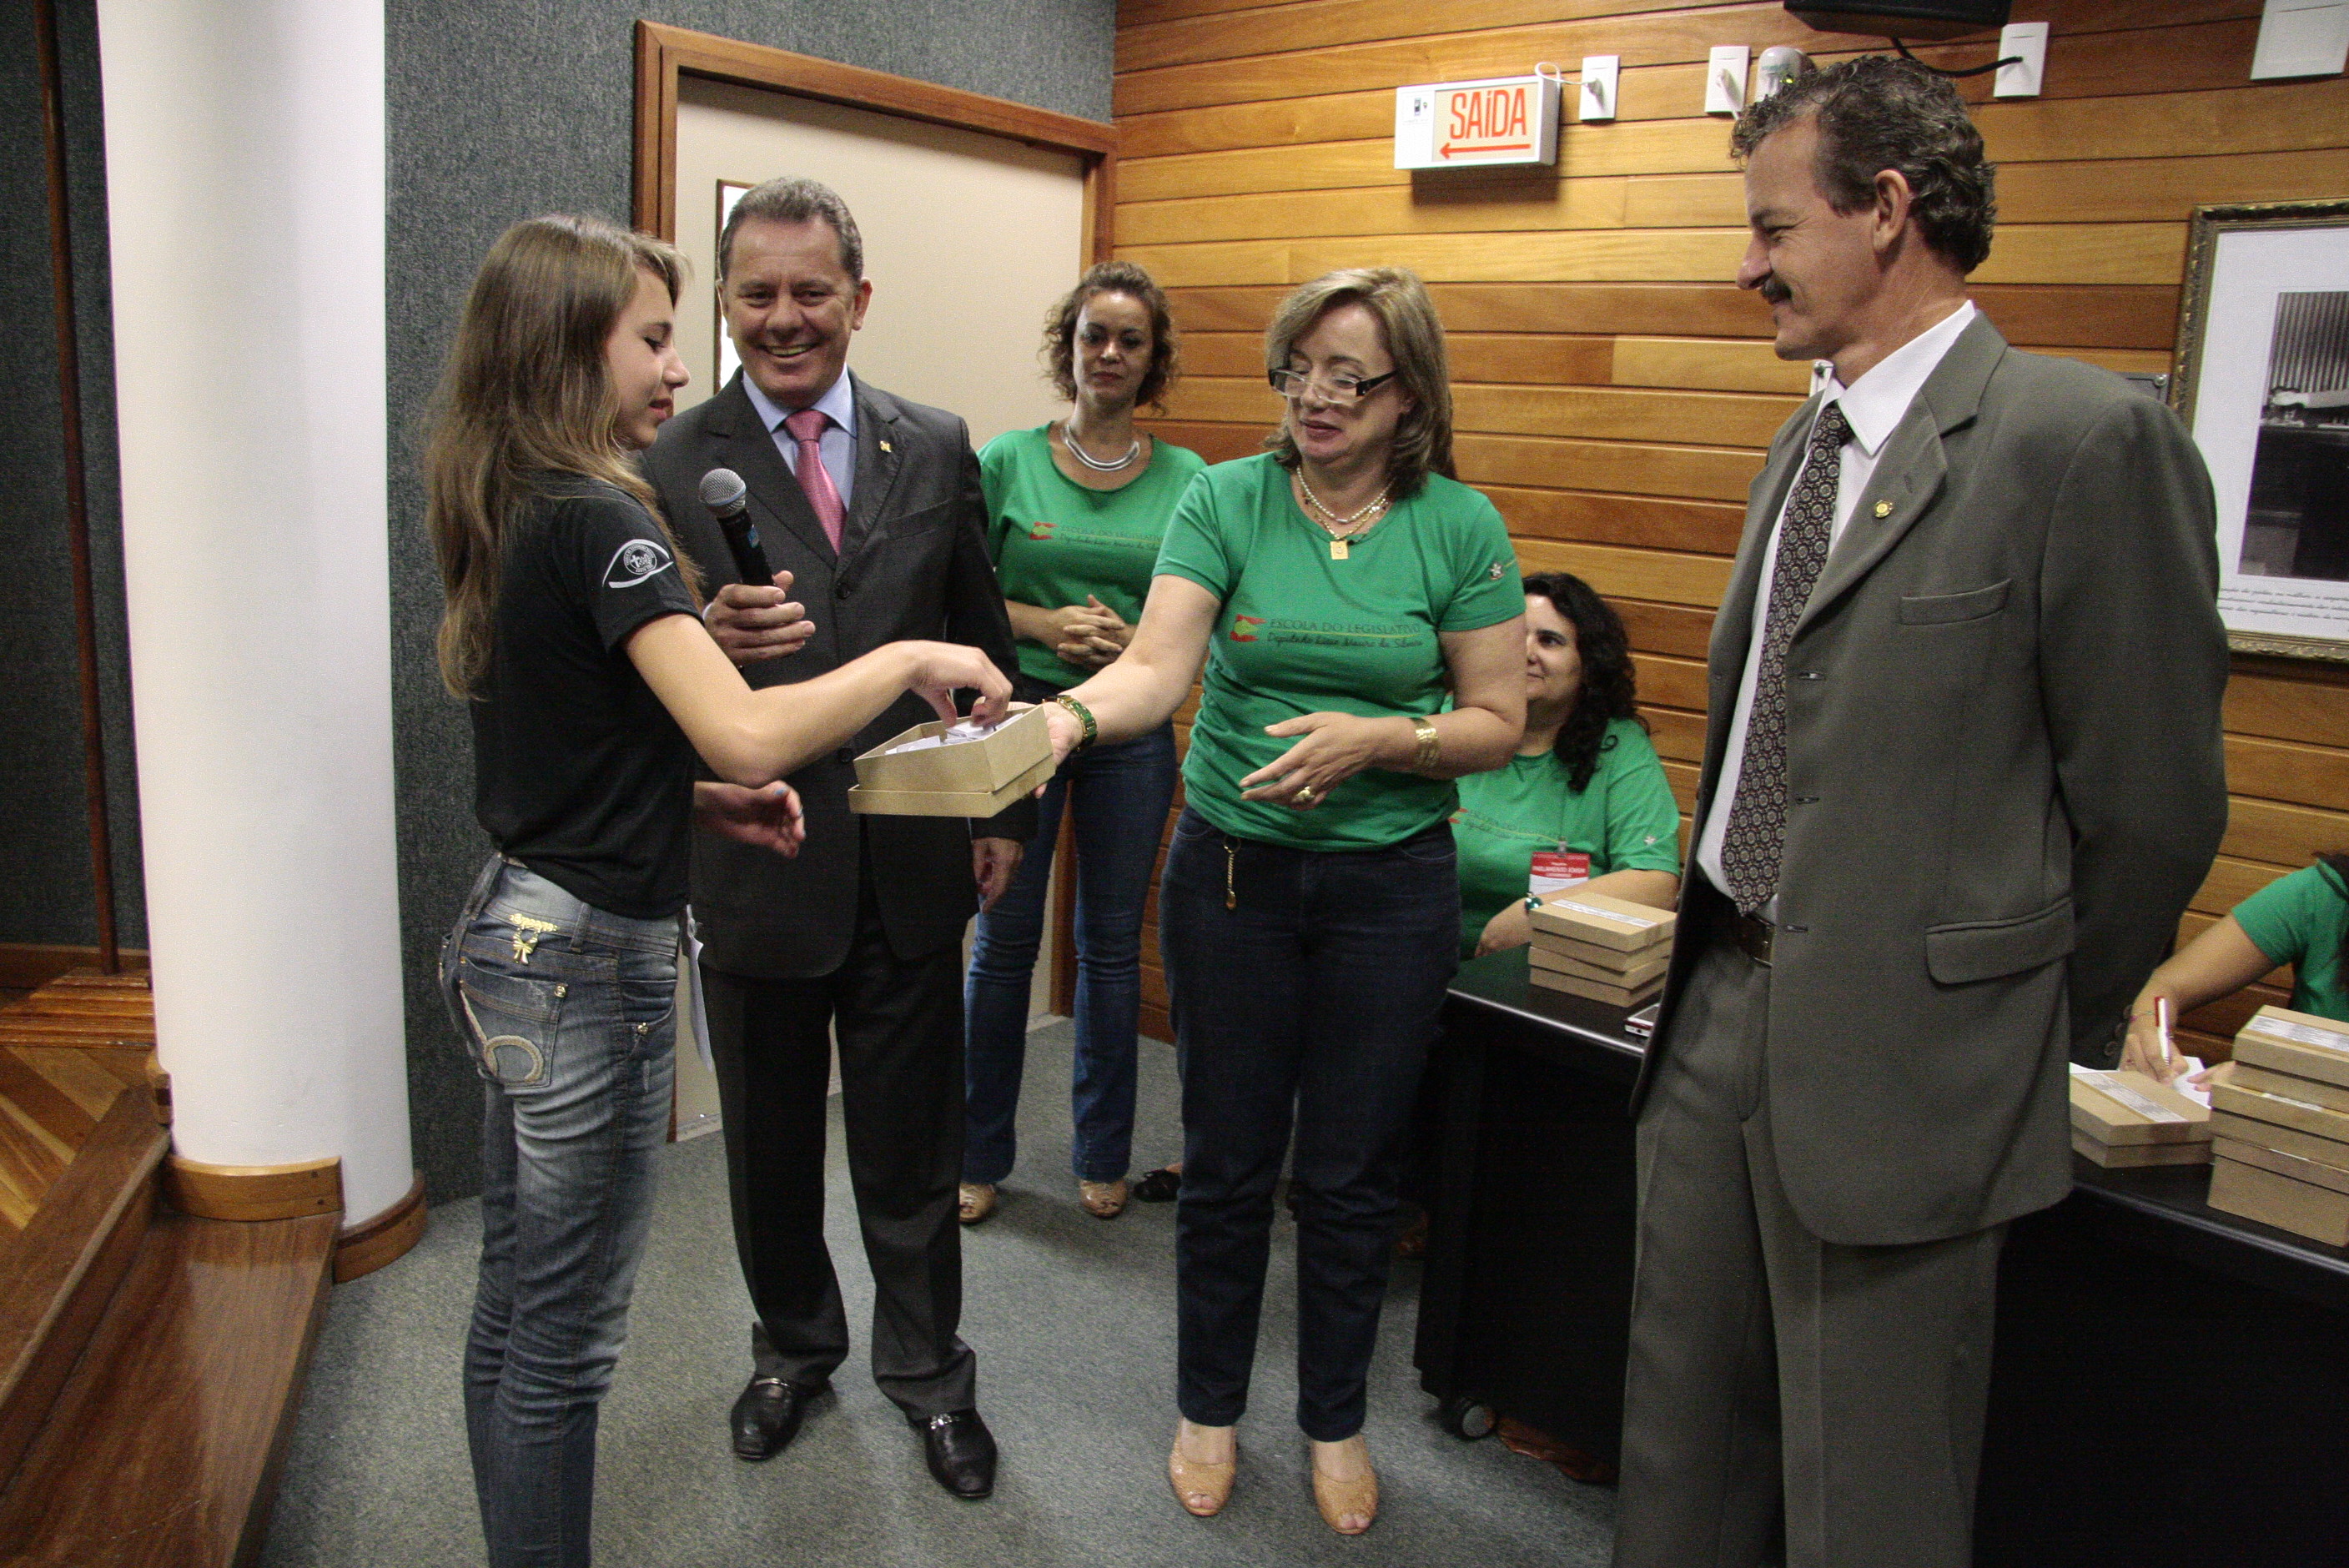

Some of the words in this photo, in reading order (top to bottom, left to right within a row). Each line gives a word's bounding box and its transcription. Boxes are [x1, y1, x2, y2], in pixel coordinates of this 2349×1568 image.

[1451, 88, 1527, 139] SAÍDA
[1270, 619, 1317, 631] ESCOLA
[1322, 621, 1343, 632] DO
[1347, 623, 1421, 635] LEGISLATIVO
